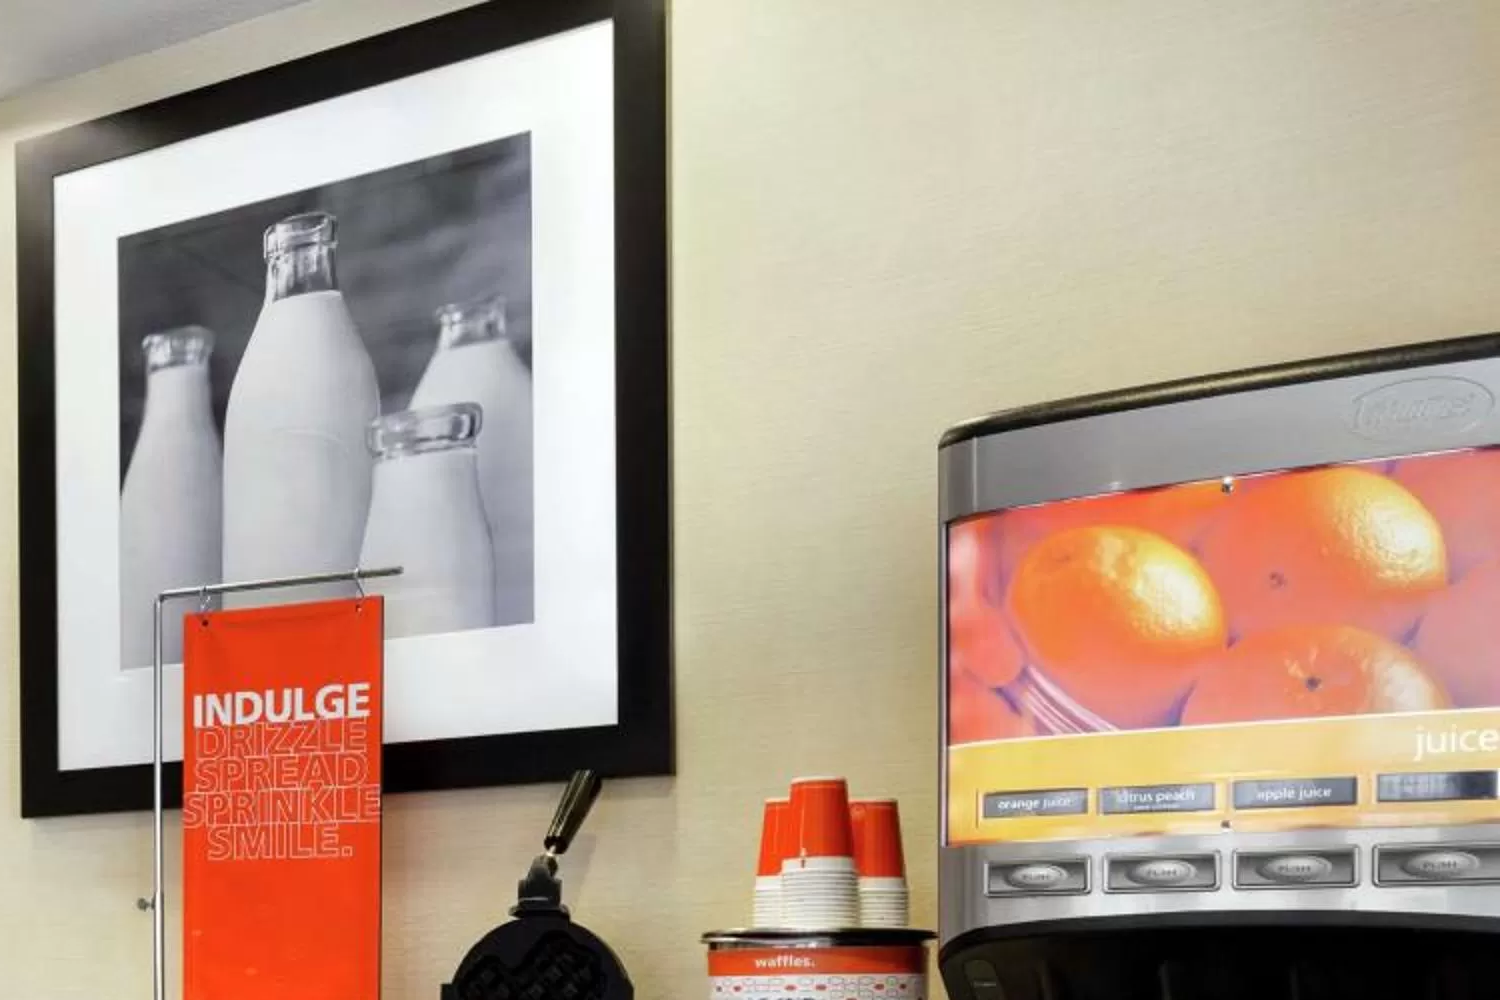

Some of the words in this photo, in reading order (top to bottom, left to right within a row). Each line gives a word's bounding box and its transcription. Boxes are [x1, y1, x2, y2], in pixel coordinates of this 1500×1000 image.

[193, 683, 371, 728] INDULGE
[196, 718, 368, 761] DRIZZLE
[1413, 724, 1500, 762] juice
[196, 751, 369, 793] SPREAD
[184, 784, 381, 829] SPRINKLE
[997, 799, 1040, 811] orange
[207, 822, 354, 861] SMILE.
